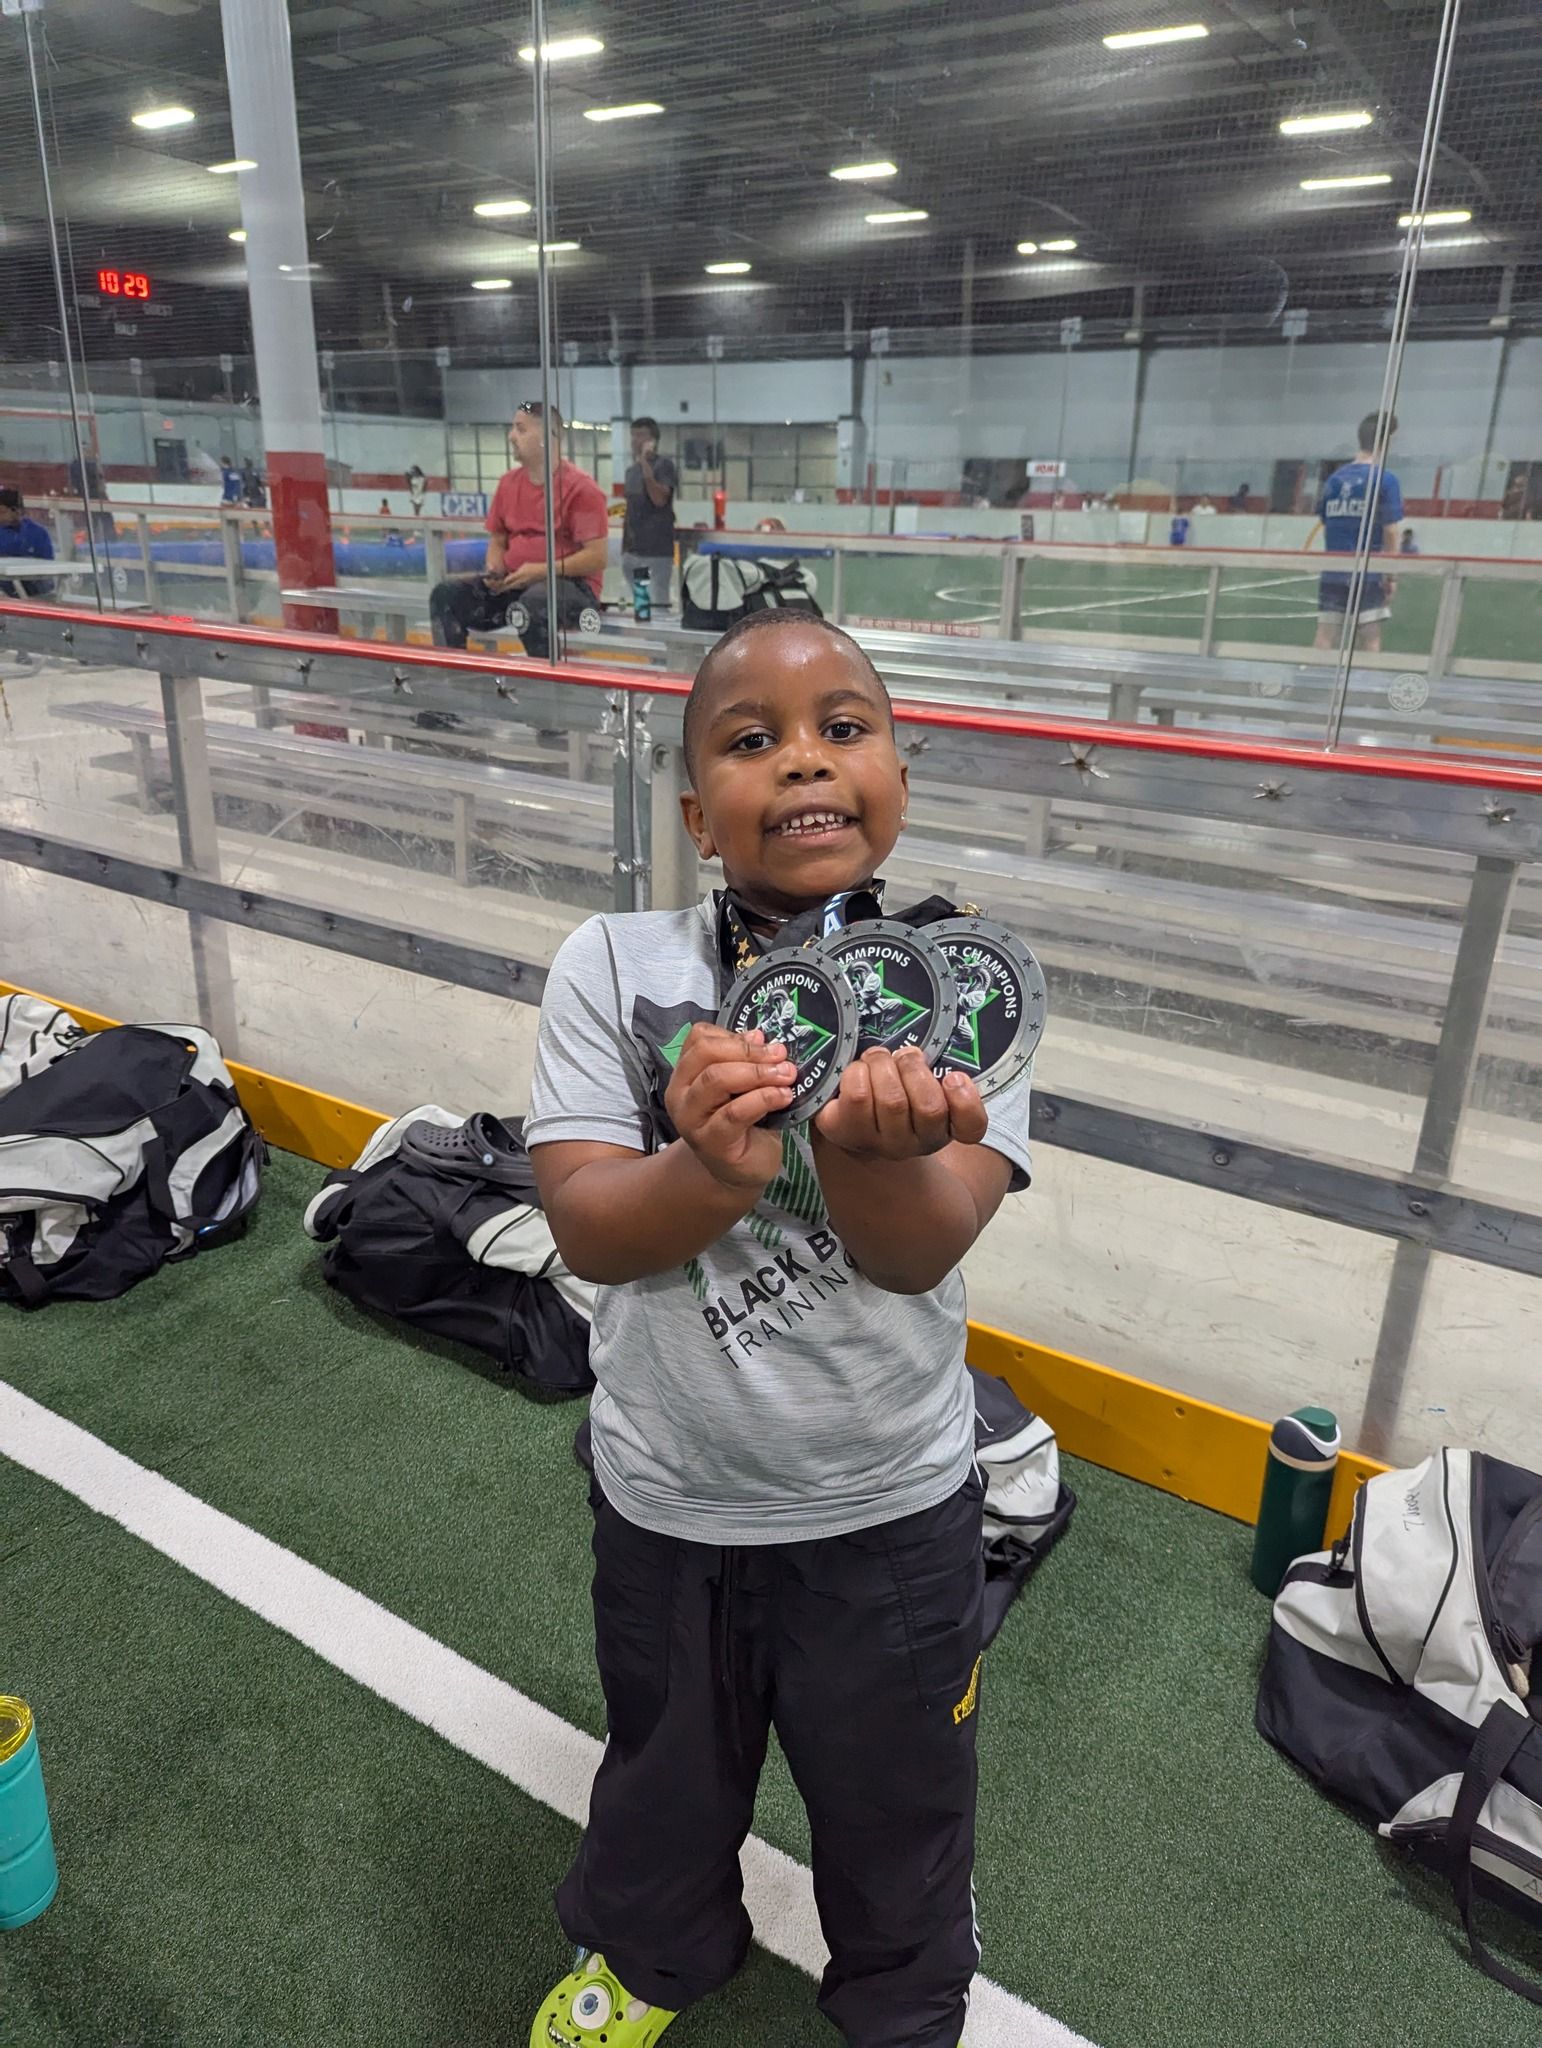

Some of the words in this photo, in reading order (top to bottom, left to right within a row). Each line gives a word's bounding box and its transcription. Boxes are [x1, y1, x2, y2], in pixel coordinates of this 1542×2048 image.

[837, 946, 911, 968] HAMPIONS
[751, 973, 821, 1004] CHAMPIONS
[962, 946, 1017, 1019] CHAMPIONS
[791, 1058, 827, 1099] EAGUE
[702, 1248, 811, 1341] BLACK
